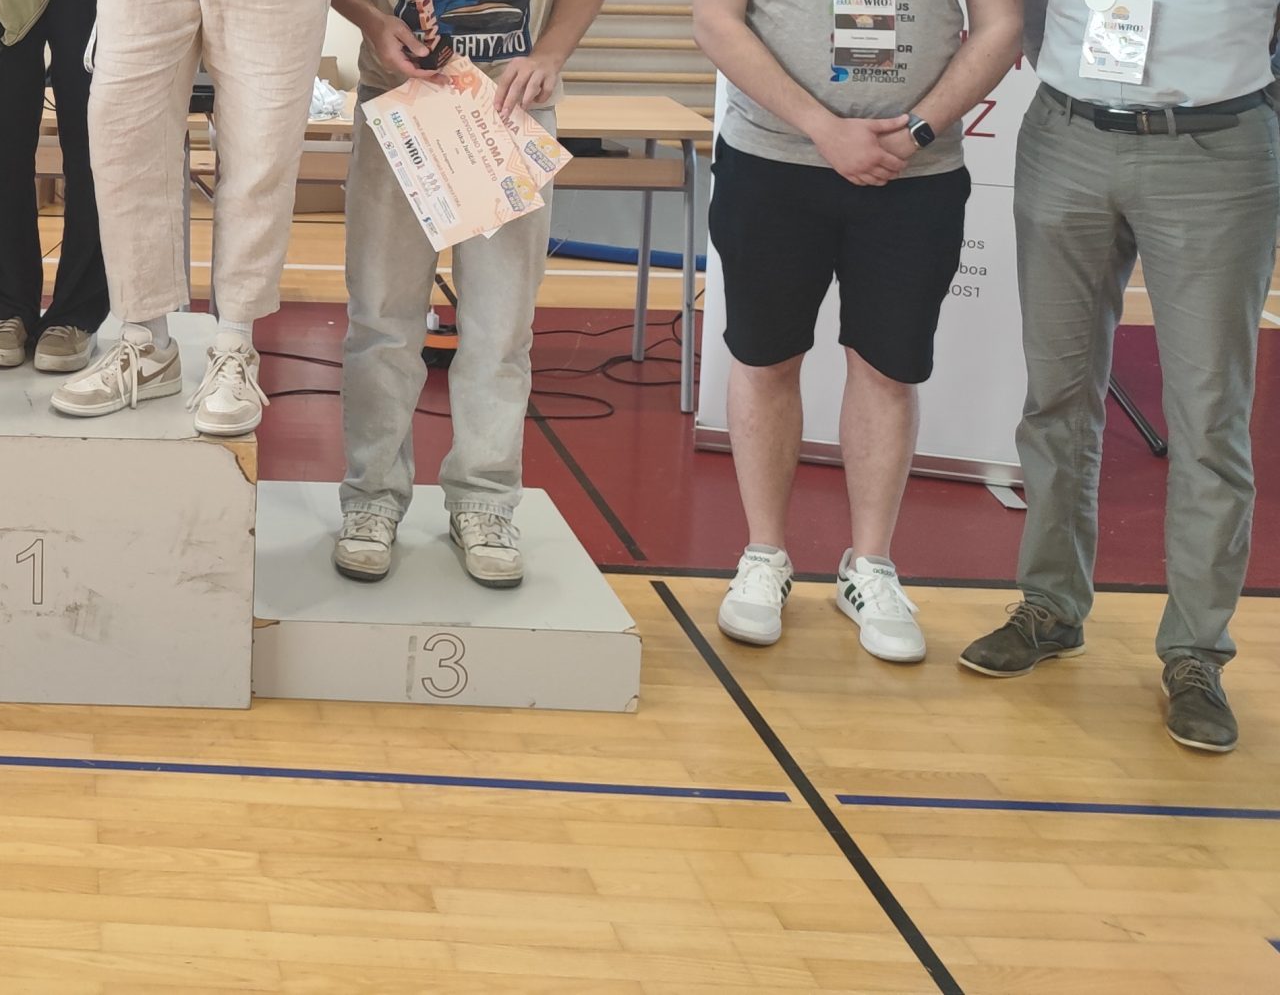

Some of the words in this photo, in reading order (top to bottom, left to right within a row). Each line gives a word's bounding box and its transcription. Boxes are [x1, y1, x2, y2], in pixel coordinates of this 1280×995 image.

[1118, 23, 1140, 32] WRO
[404, 137, 423, 166] WRO
[454, 105, 462, 115] ZA
[459, 114, 481, 149] OSVOJENO
[481, 157, 498, 183] MJESTO
[455, 129, 465, 145] Nika
[470, 109, 505, 168] DIPLOMA
[16, 538, 44, 605] 1
[421, 632, 469, 699] 3
